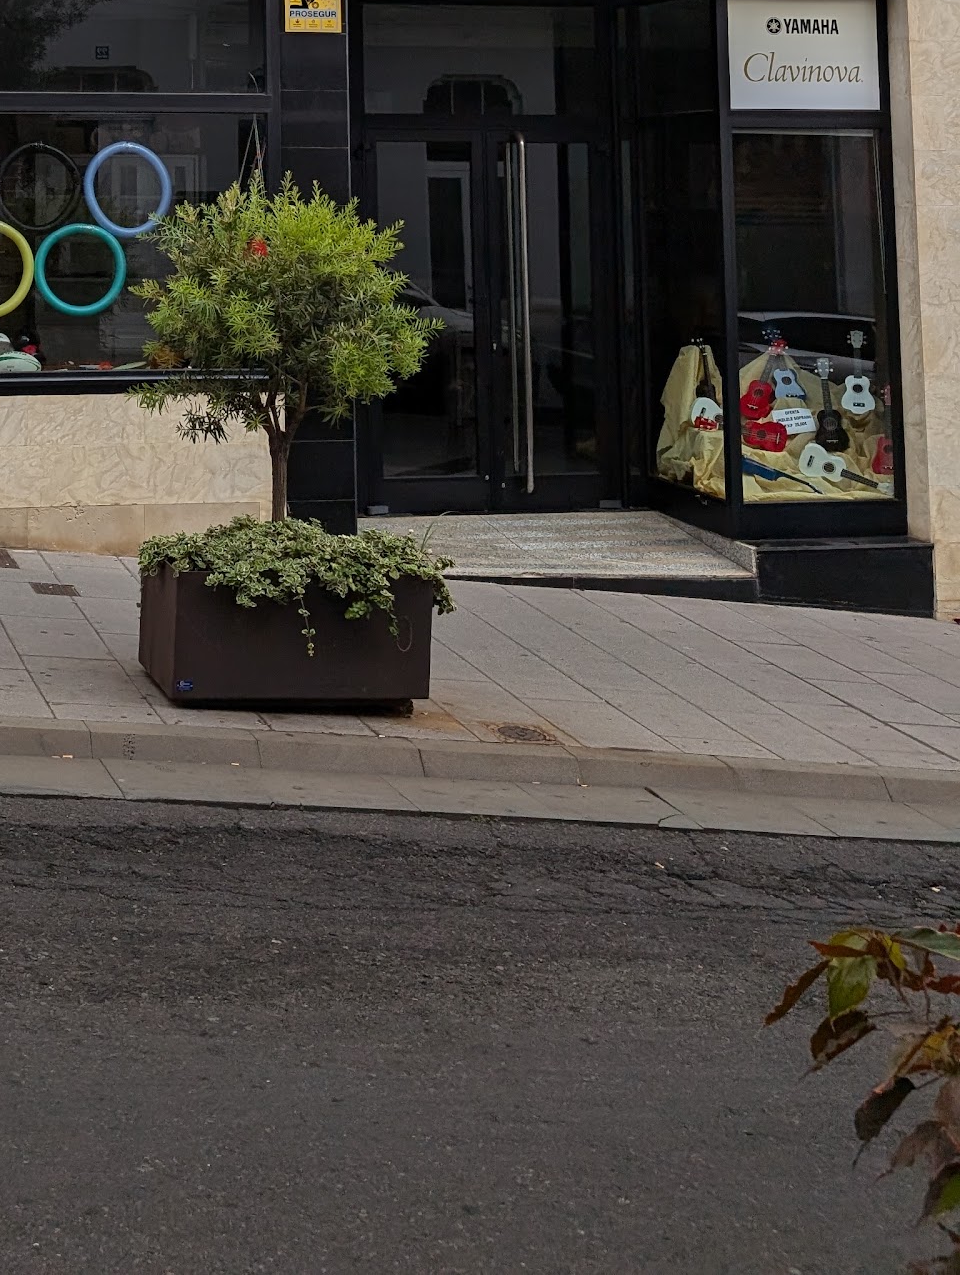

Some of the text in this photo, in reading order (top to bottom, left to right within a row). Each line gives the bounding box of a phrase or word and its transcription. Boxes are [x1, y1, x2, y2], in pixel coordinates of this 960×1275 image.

[289, 10, 337, 18] PROSEGUR
[783, 18, 839, 35] YAMAHA
[743, 51, 861, 83] Clavinova
